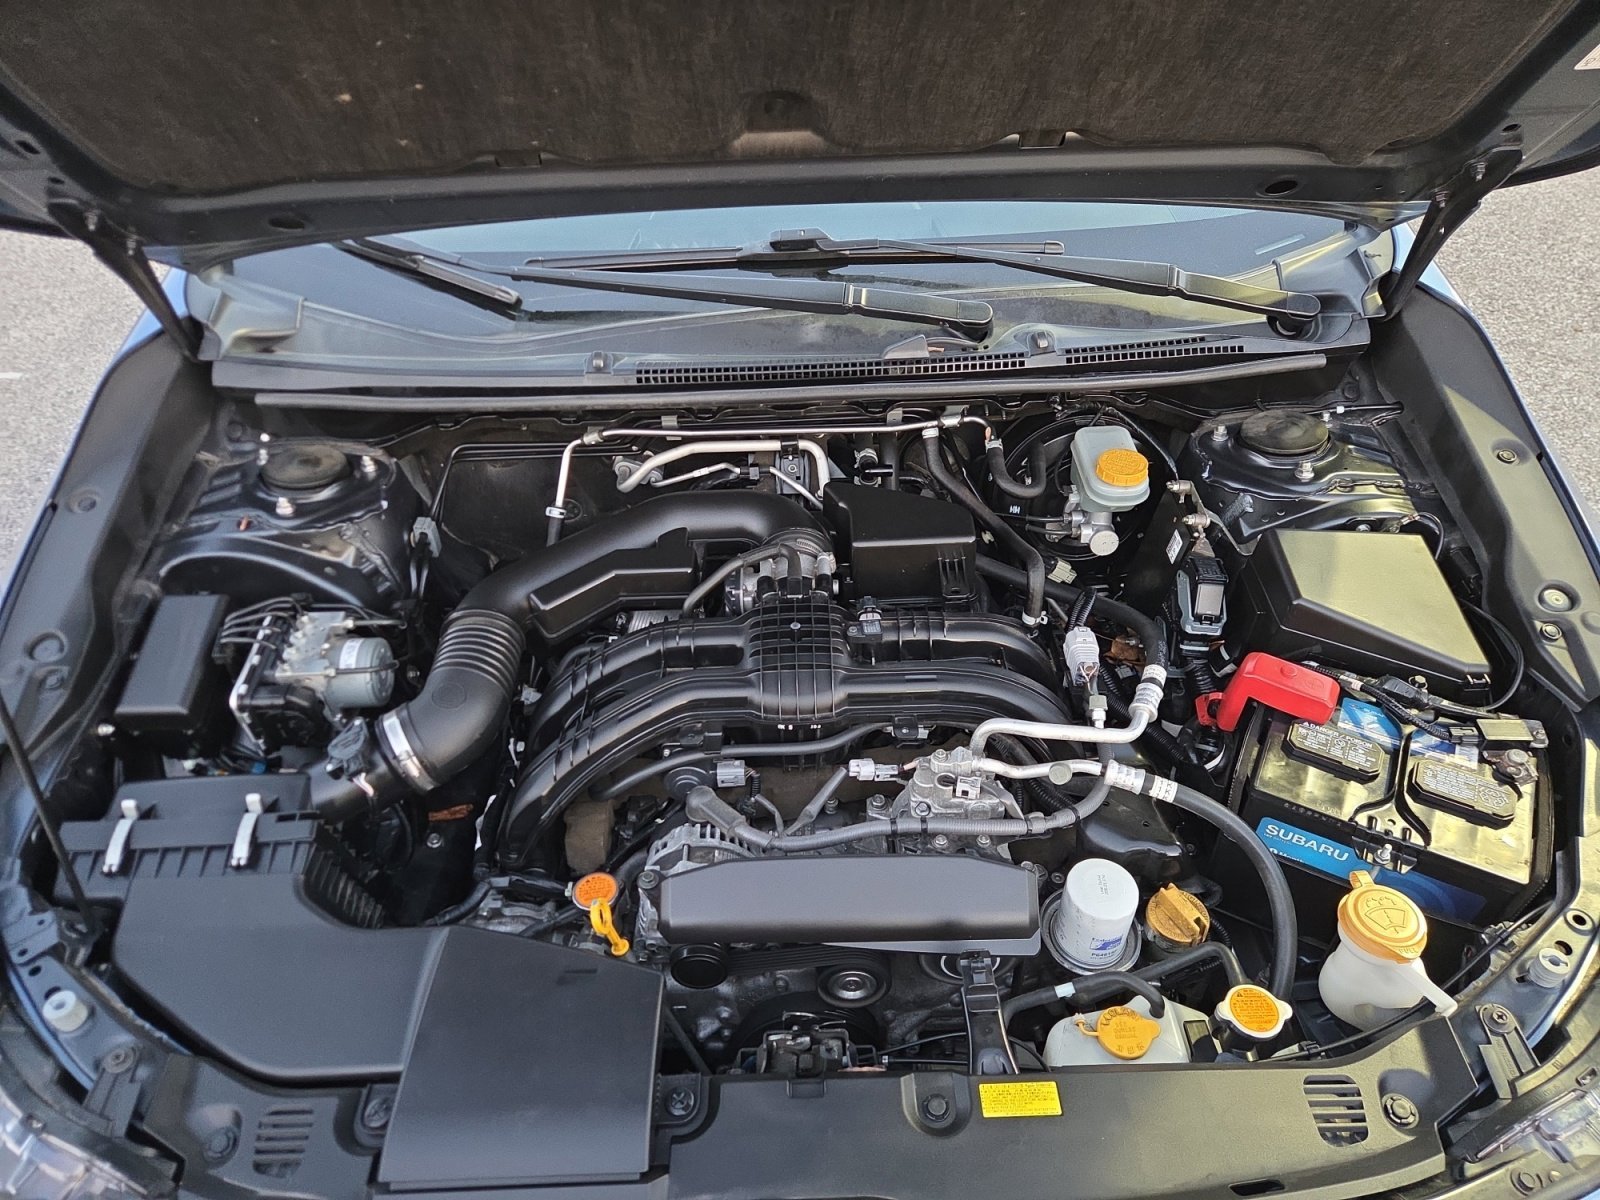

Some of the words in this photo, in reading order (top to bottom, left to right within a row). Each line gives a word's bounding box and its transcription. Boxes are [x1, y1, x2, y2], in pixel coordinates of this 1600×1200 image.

[1310, 723, 1339, 737] DANGER
[1346, 735, 1373, 749] POISON
[1265, 824, 1349, 861] SUBARU
